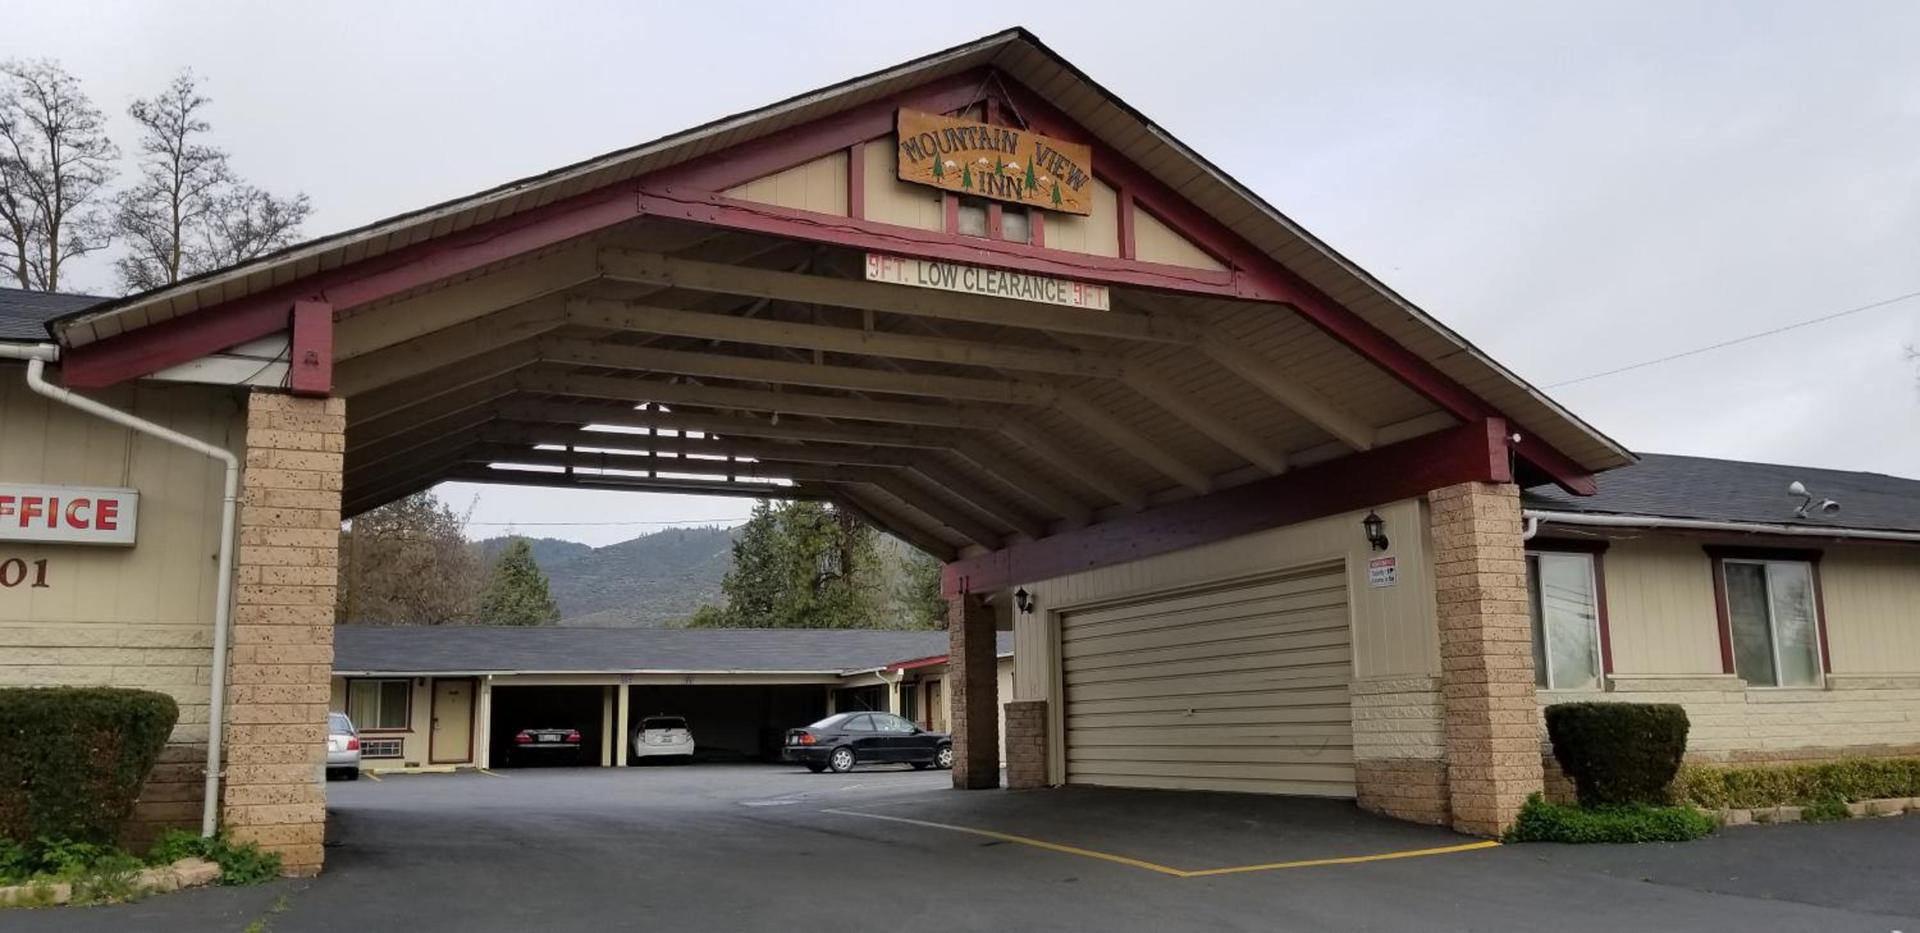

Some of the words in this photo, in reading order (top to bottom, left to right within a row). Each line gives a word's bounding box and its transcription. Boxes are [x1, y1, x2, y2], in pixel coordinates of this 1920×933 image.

[901, 126, 1019, 164] MOUNTAIN
[1034, 141, 1089, 192] VIEW
[979, 171, 1023, 200] INN
[917, 261, 958, 290] LOW
[963, 267, 1067, 303] CLEARANCE
